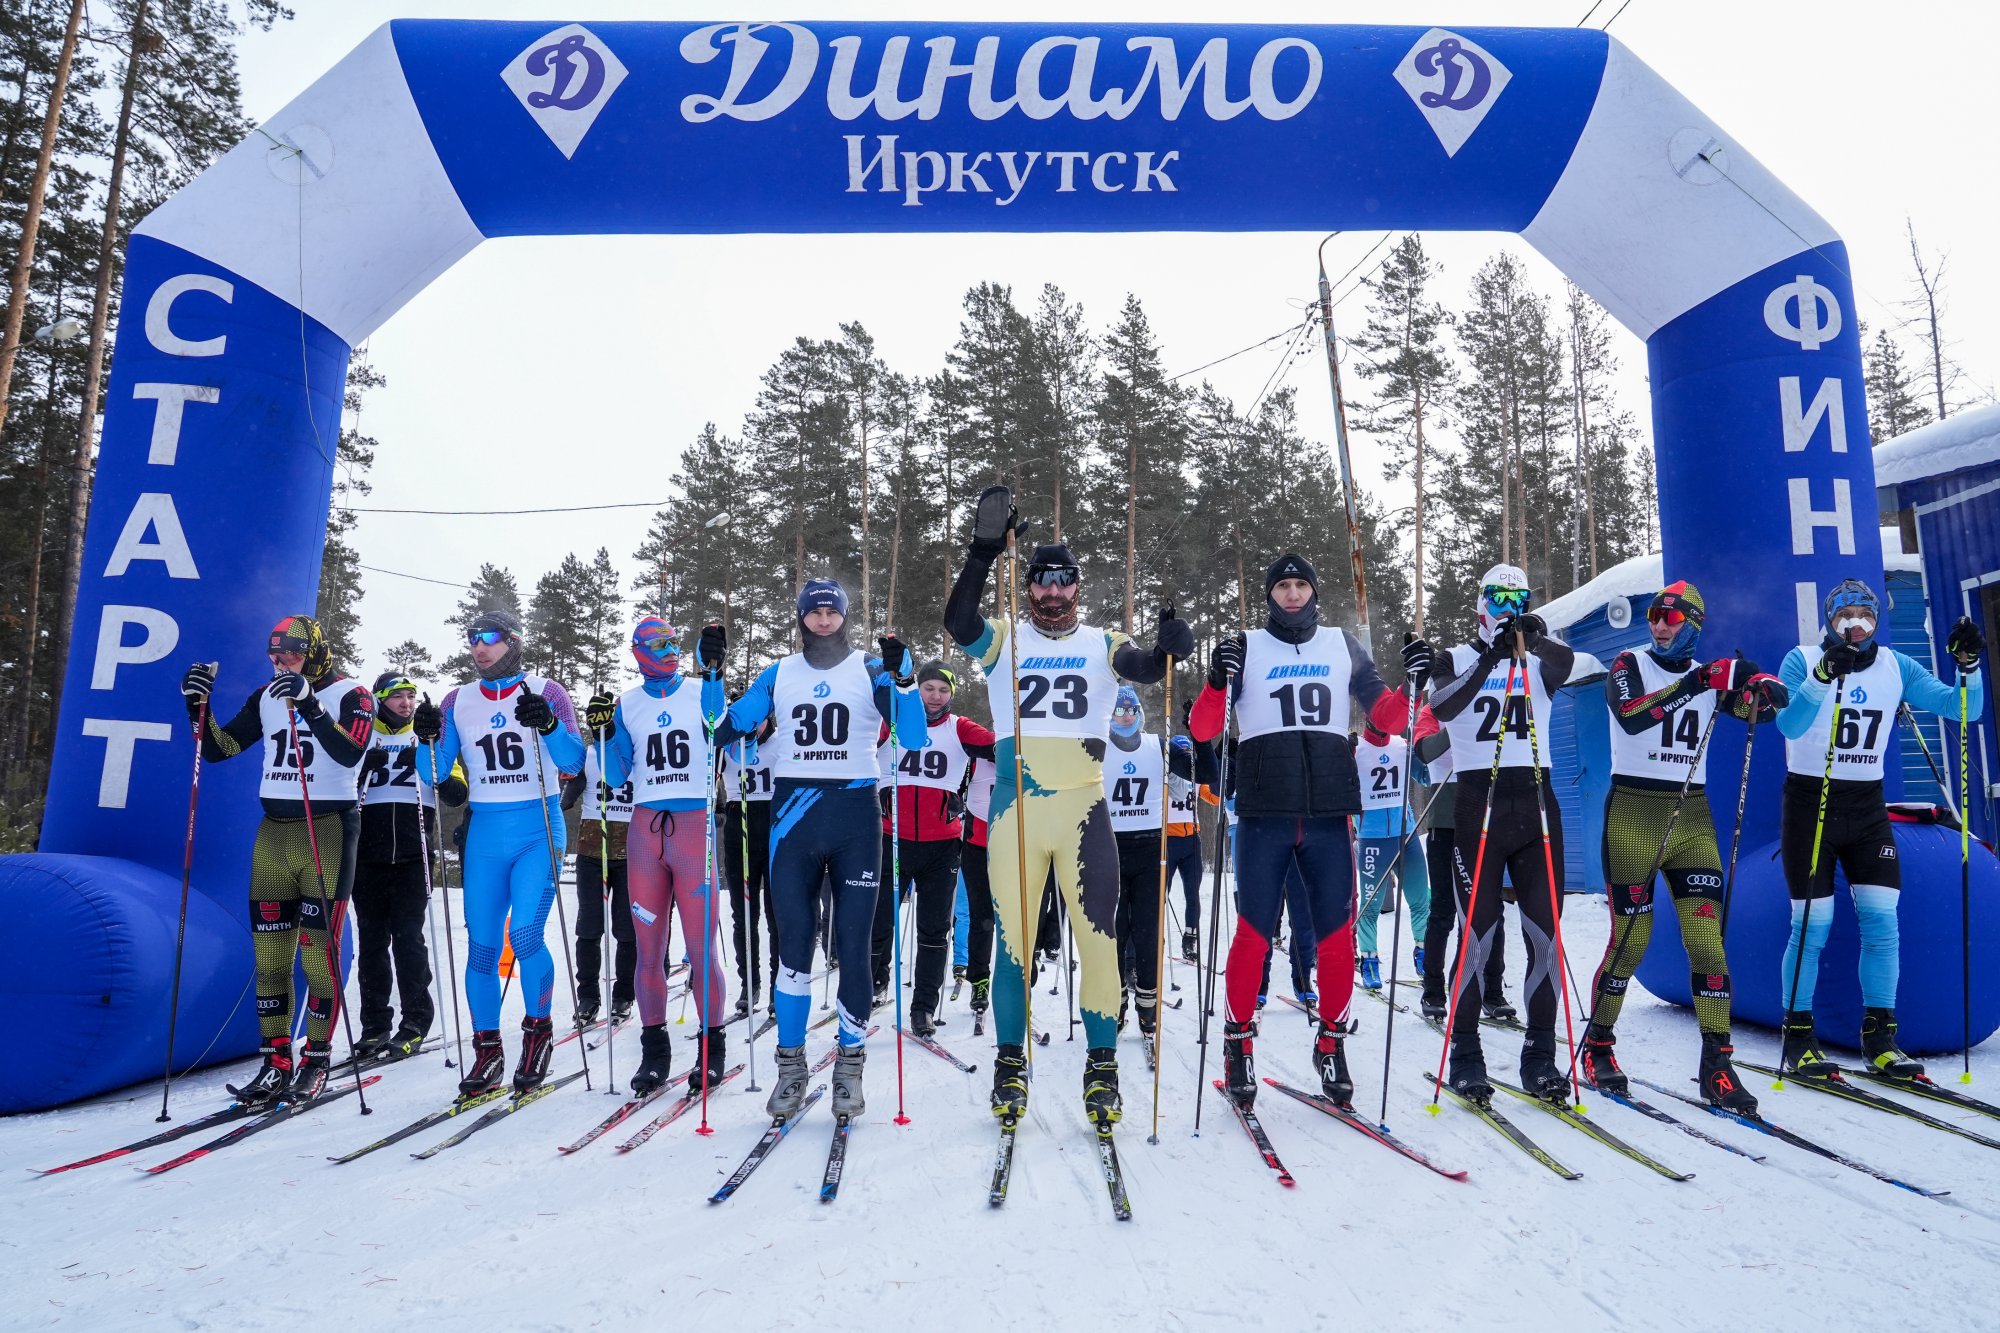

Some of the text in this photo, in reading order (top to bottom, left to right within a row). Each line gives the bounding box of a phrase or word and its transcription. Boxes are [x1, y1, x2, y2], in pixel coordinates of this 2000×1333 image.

[679, 20, 1323, 123] Динамо
[843, 134, 1180, 206] Иркутск
[82, 273, 234, 809] СТАРТ
[1020, 656, 1087, 669] ДИНАМО
[1265, 664, 1331, 680] ДИНАМО
[1018, 674, 1089, 720] 23
[1616, 677, 1631, 700] Audi
[1269, 682, 1332, 728] 19
[1473, 694, 1530, 742] 24
[791, 702, 850, 747] 30
[1661, 709, 1700, 750] 14
[1834, 708, 1883, 750] 67
[270, 728, 315, 769] 15
[476, 731, 525, 771] 16
[646, 729, 690, 772] 46
[803, 750, 848, 761] ИРКУТСК
[1838, 754, 1879, 764] ИРКУТСК
[488, 773, 529, 784] ИРКУТСК
[655, 773, 690, 785] ИРКУТСК
[898, 749, 948, 780] 49
[1370, 766, 1399, 791] 21
[596, 778, 634, 804] 33
[737, 767, 771, 794] 31
[1112, 777, 1149, 807] 47
[606, 805, 633, 813] РКУТСК
[1118, 809, 1149, 818] ИРКУТСК
[1362, 846, 1379, 879] Easy
[1454, 846, 1473, 885] CRAFT
[256, 921, 292, 931] WÜRTH
[1701, 990, 1730, 998] WÜRTH
[461, 1087, 509, 1112] FISCHER
